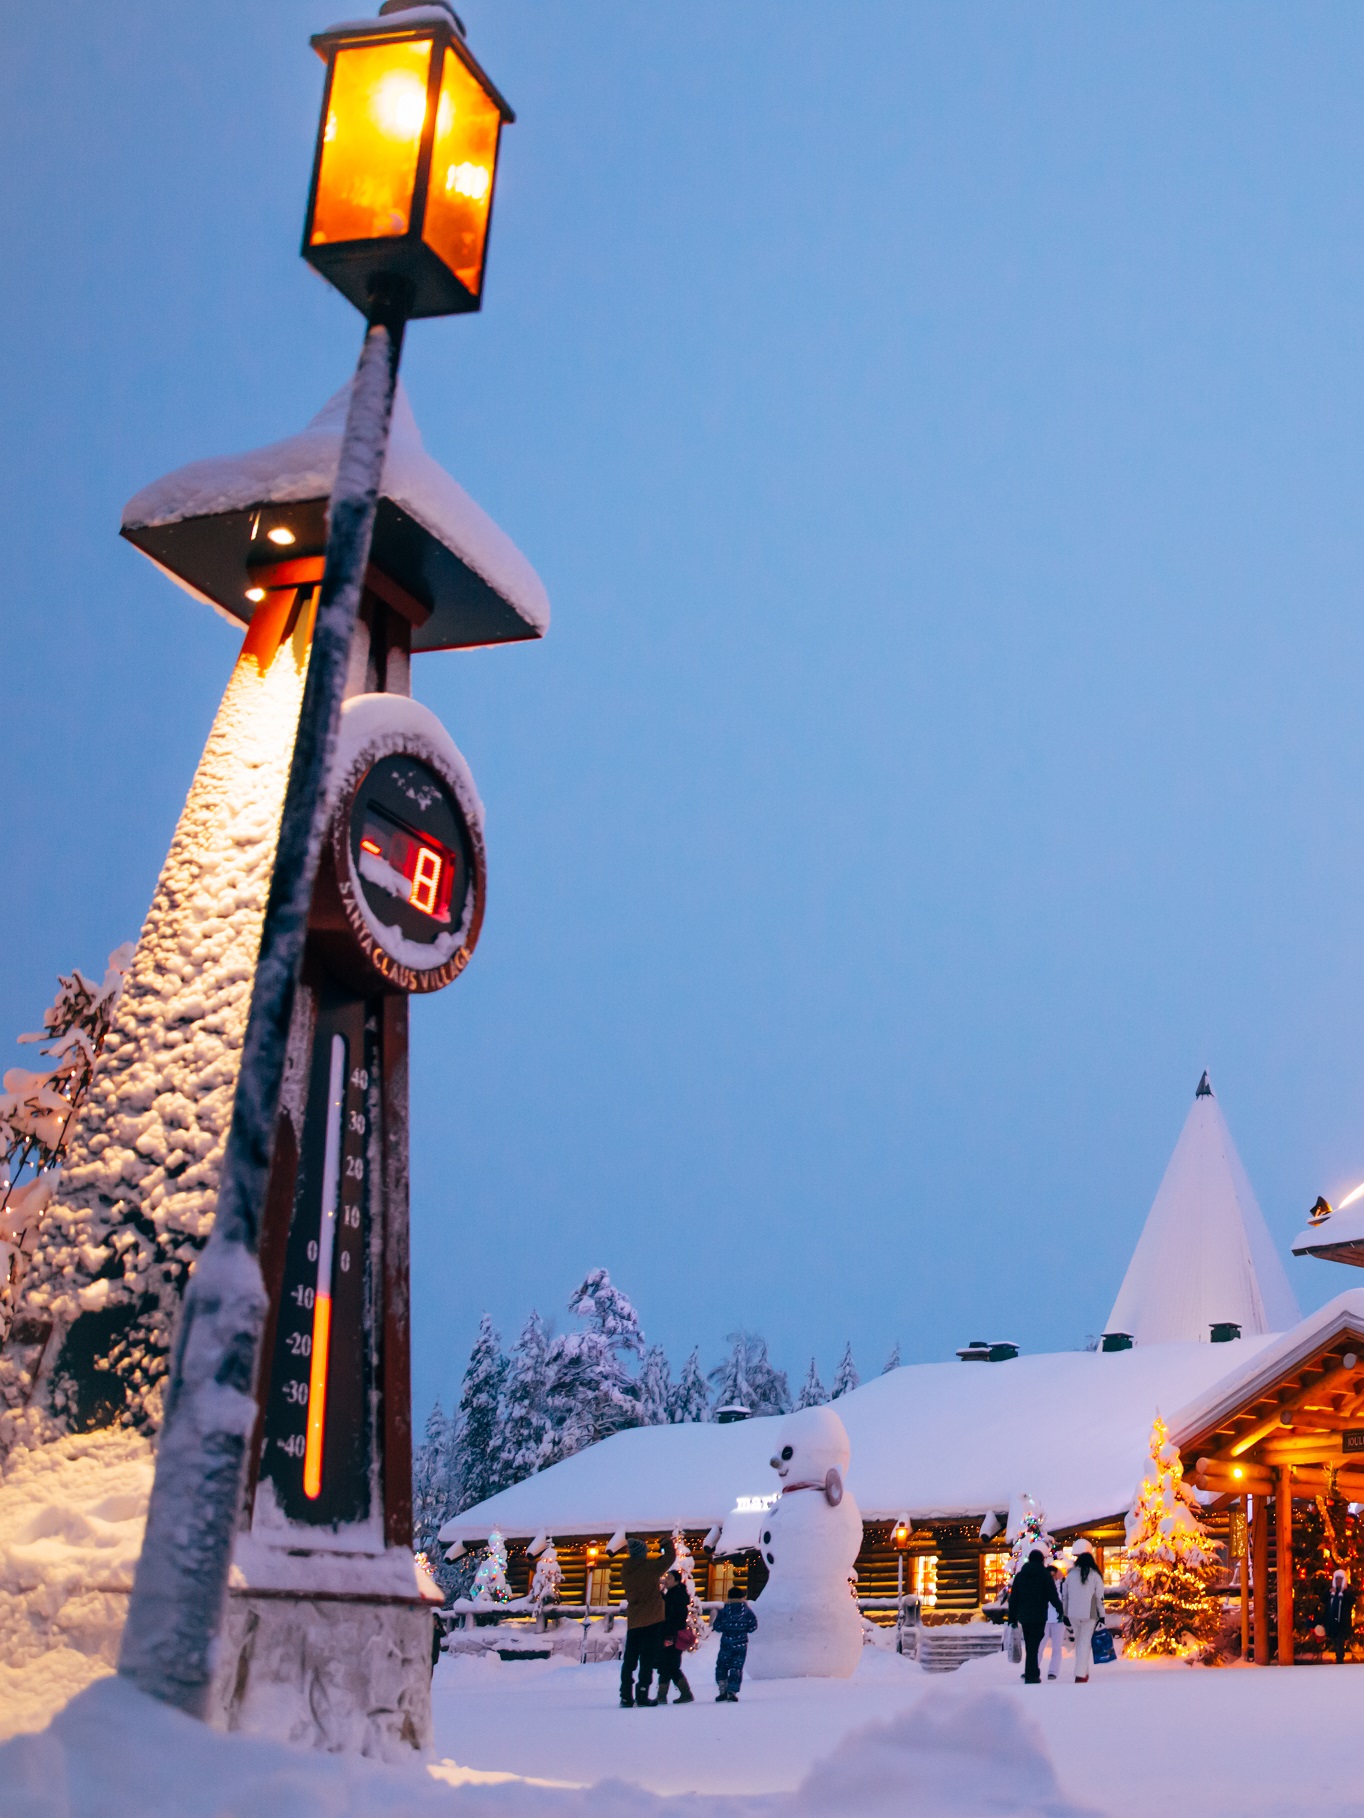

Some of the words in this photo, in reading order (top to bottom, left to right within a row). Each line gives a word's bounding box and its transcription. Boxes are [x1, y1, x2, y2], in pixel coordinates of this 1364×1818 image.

[372, 947, 417, 990] CLAUS
[350, 1067, 368, 1090] 40
[348, 1110, 366, 1134] 30
[346, 1155, 364, 1180] 20
[344, 1205, 360, 1228] 10
[307, 1239, 318, 1262] 0
[340, 1250, 350, 1272] 0
